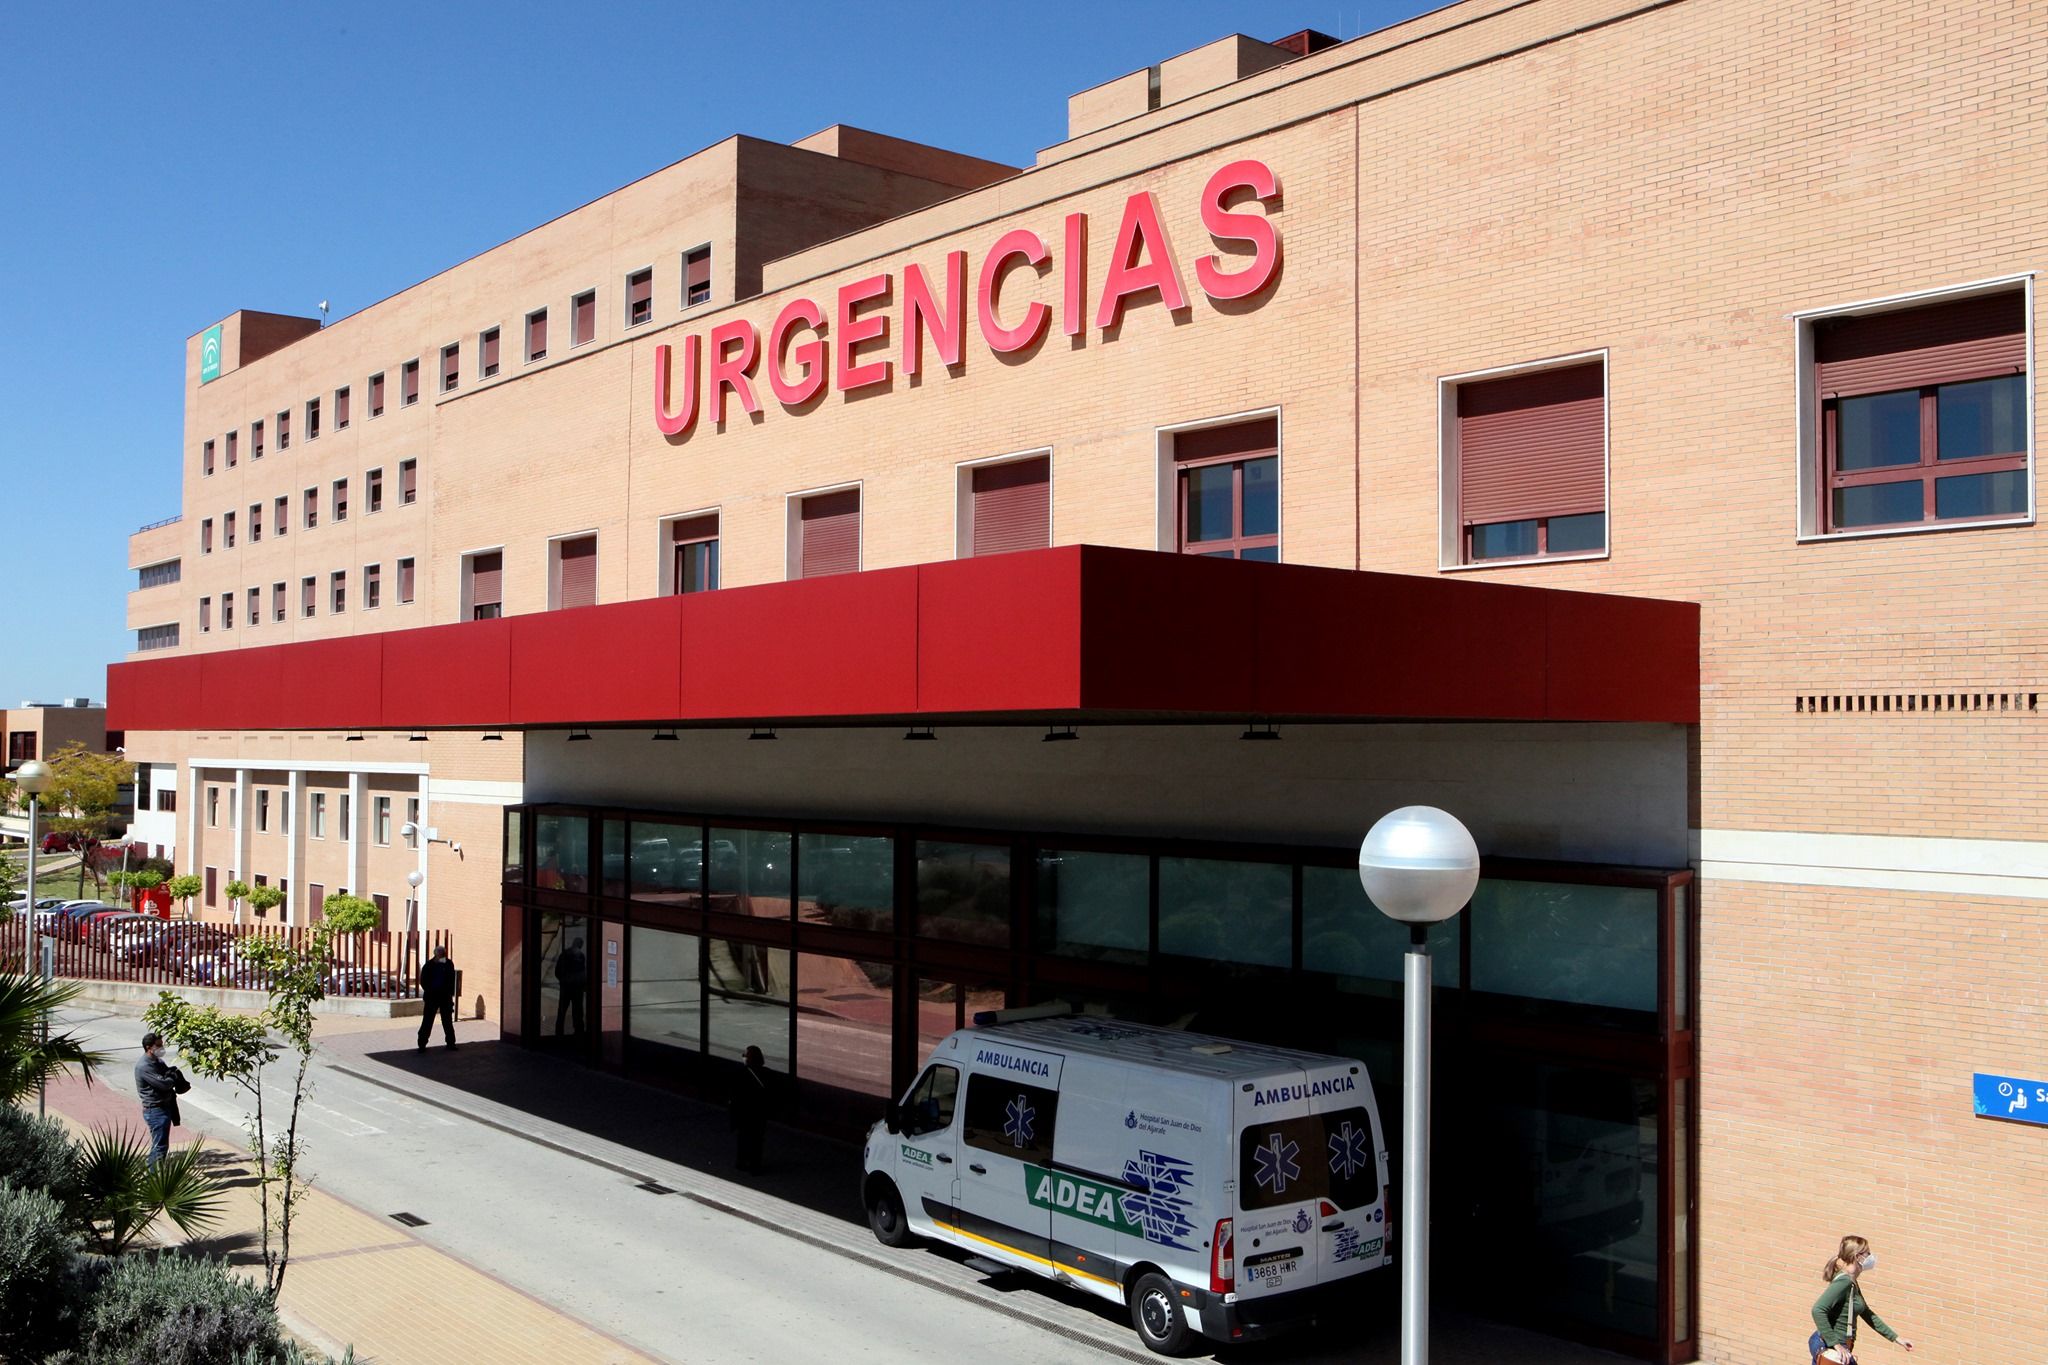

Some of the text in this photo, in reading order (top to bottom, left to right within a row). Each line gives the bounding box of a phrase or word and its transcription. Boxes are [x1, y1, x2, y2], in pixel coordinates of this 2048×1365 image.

[655, 159, 1284, 437] URGENCIAS
[976, 1050, 1049, 1078] AMBULANCIA
[1254, 1076, 1356, 1107] AMBULANCIA
[1140, 1113, 1160, 1123] Hospital
[1160, 1117, 1169, 1126] San
[1170, 1119, 1182, 1128] Juan
[1190, 1123, 1202, 1132] Dios
[903, 1147, 929, 1162] ADEA
[1034, 1174, 1116, 1223] ADEA
[1358, 1239, 1382, 1255] ADEA
[1260, 1253, 1291, 1264] MASTER
[1279, 1260, 1297, 1275] HWR
[1268, 1277, 1282, 1288] SP
